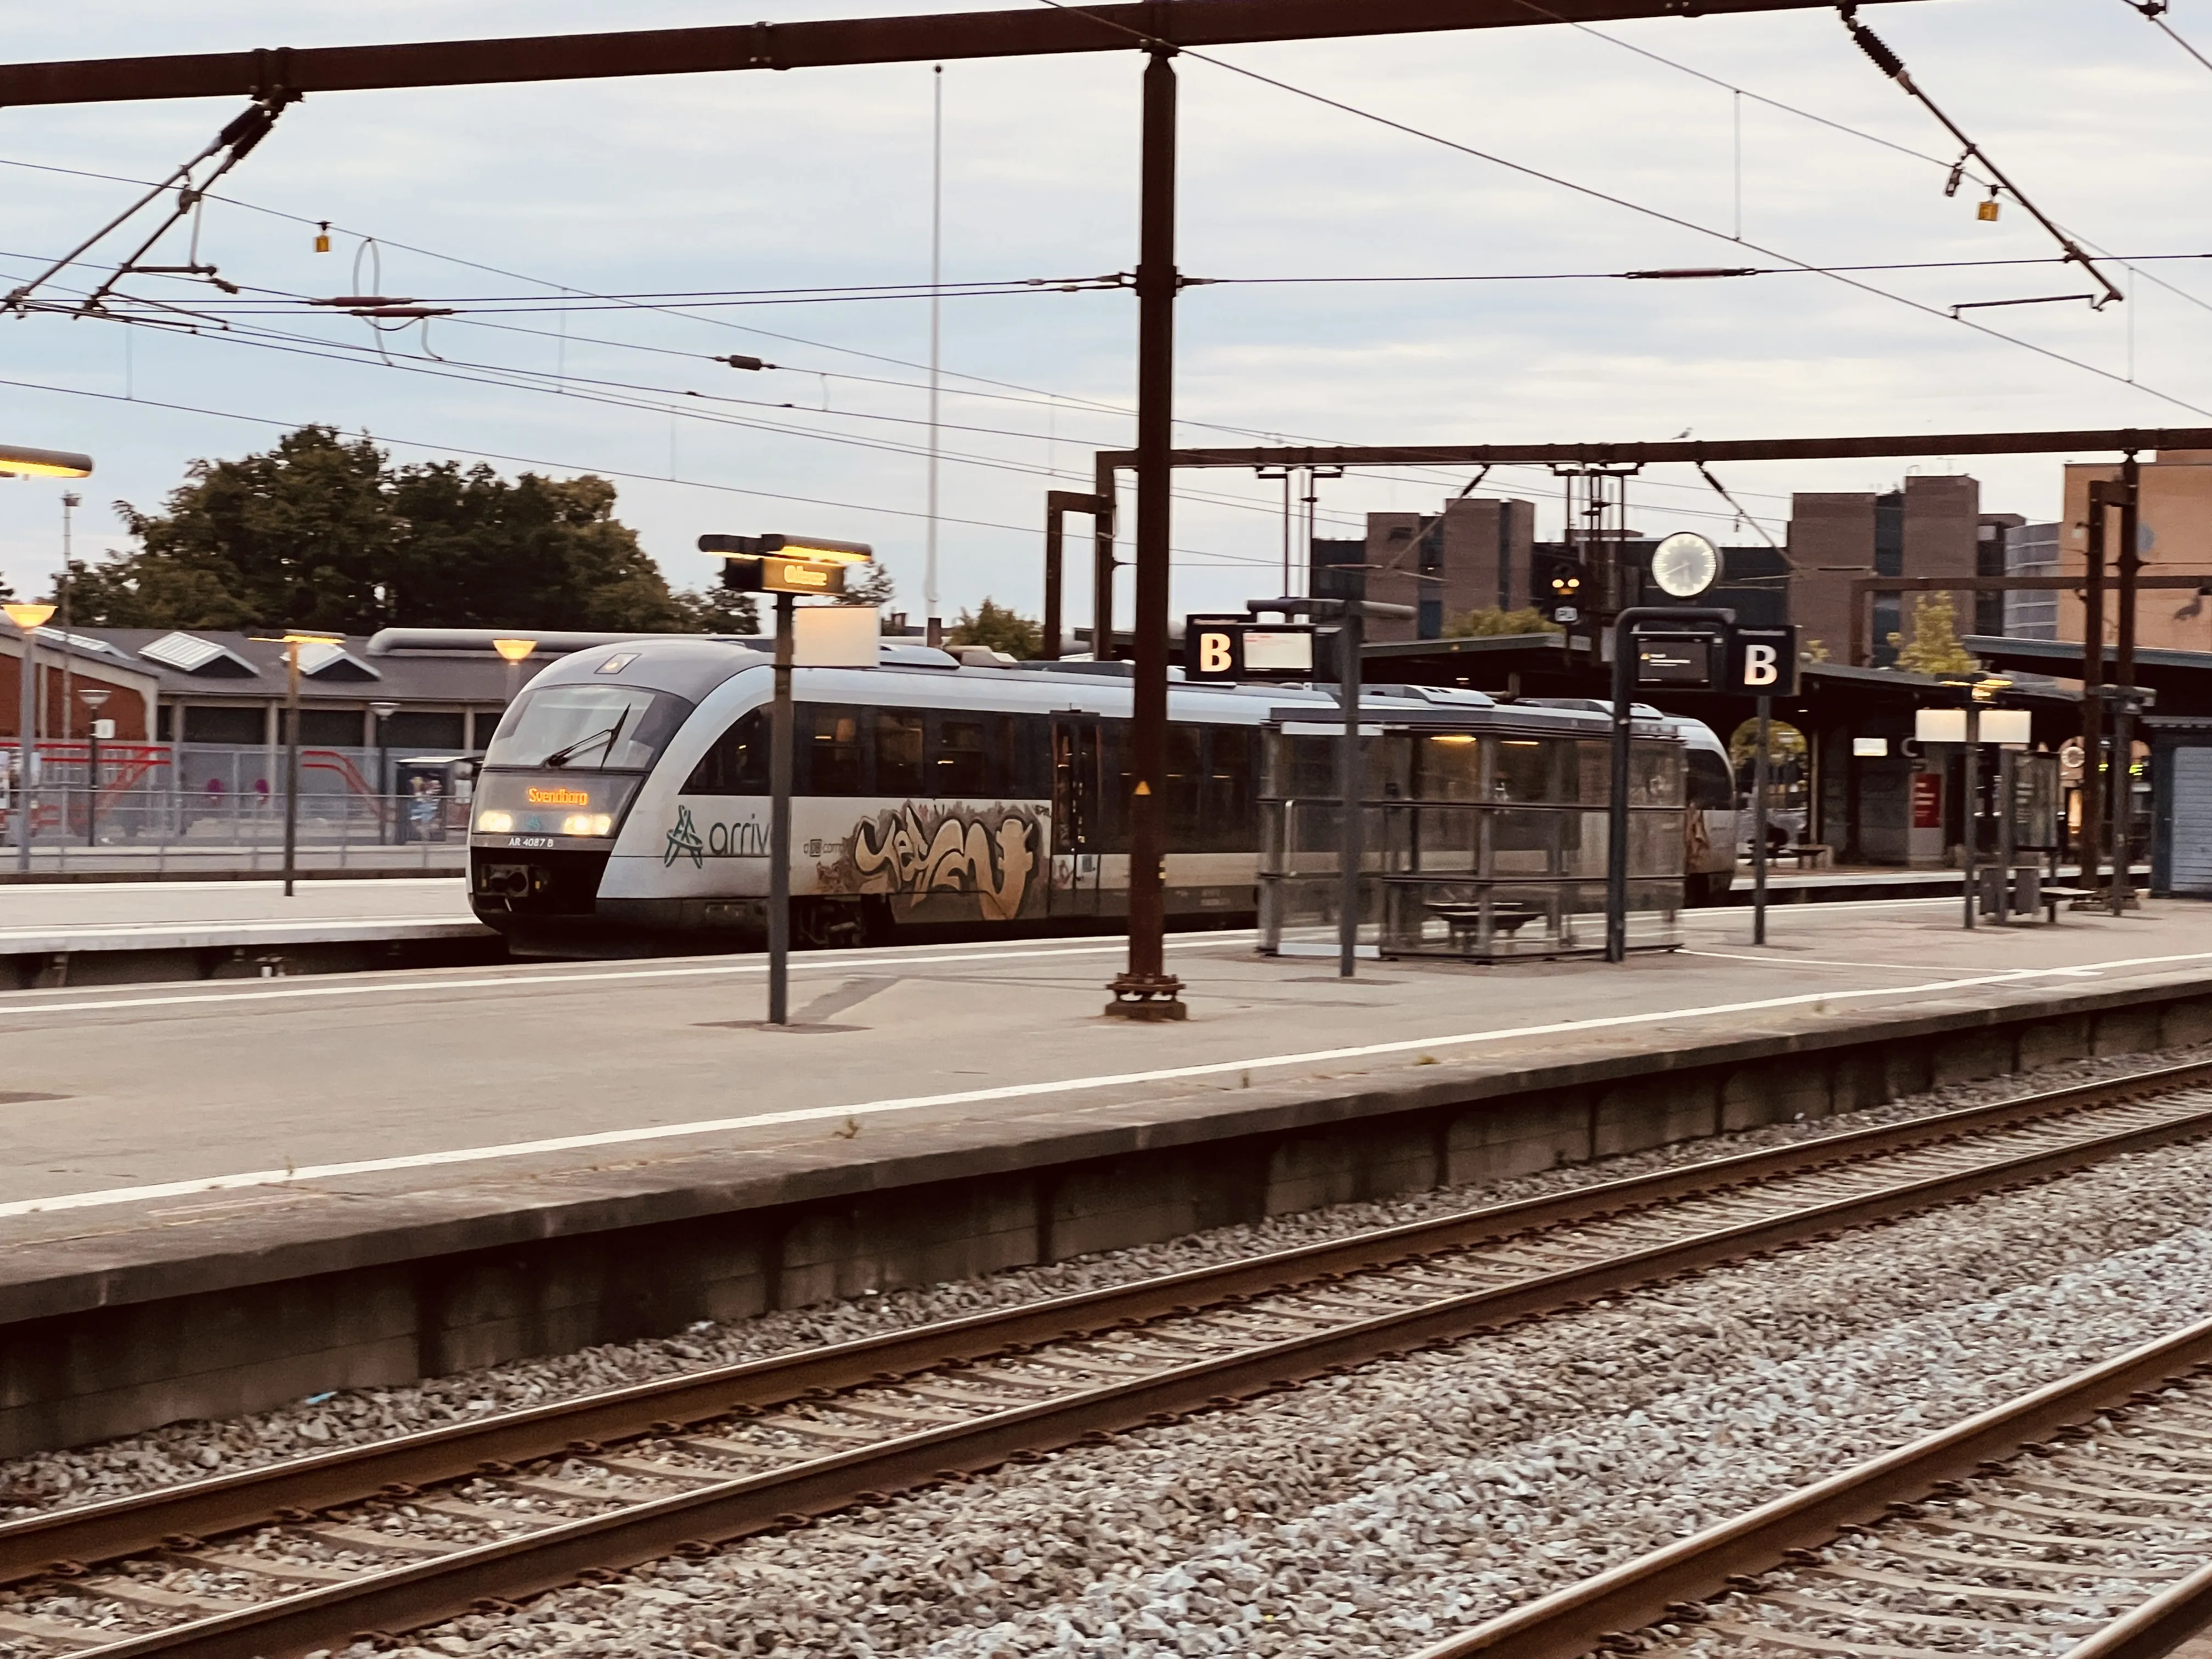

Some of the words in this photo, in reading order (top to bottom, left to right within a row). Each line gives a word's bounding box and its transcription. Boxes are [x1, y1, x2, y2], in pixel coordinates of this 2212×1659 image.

[1200, 633, 1232, 672] B
[1743, 645, 1778, 685] B
[528, 787, 588, 806] Svendborg
[508, 838, 521, 847] AR
[522, 838, 545, 847] 4087
[547, 839, 554, 848] B
[709, 813, 772, 854] arriv
